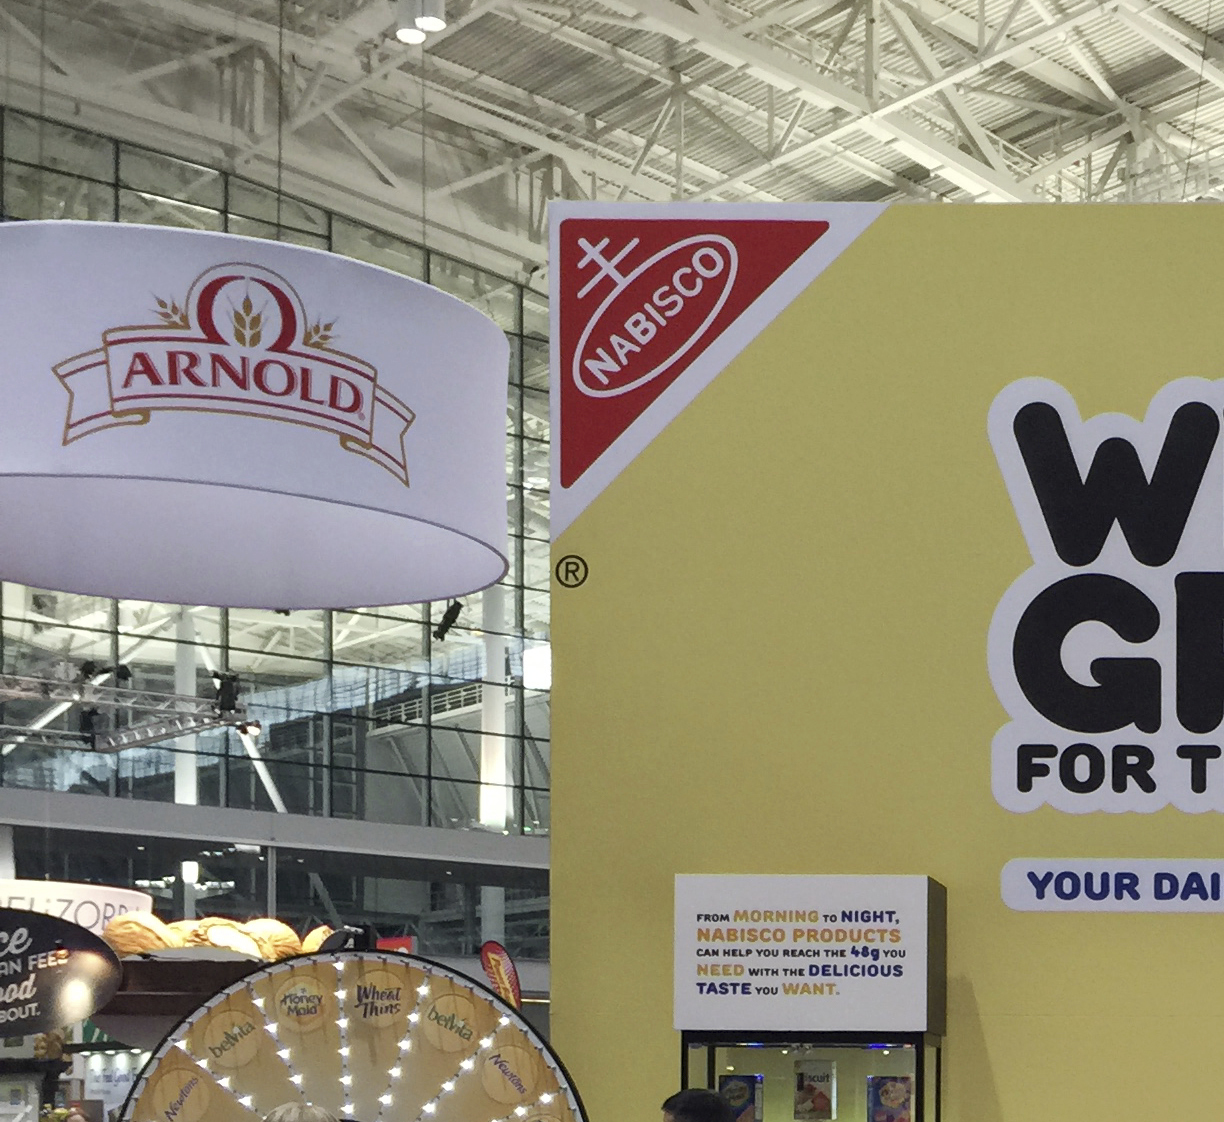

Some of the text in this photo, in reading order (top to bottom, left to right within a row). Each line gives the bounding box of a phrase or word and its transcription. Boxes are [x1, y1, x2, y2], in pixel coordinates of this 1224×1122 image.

[585, 247, 725, 385] NABISCO
[122, 350, 364, 414] ARNOLD
[1016, 744, 1157, 794] FOR
[1027, 872, 1141, 902] YOUR
[697, 910, 900, 925] FROM MORNING TO NIGHT,
[697, 928, 902, 943] NABISCO PRODUCTS
[696, 946, 906, 961] CAN HELP YOU REACH THE 48g YOU
[697, 964, 904, 977] NEED WITH THE DELICIOUS
[356, 982, 402, 1004] Wheat
[696, 982, 841, 996] TASTE YOU WANT.
[280, 993, 323, 1007] Honey
[287, 1003, 317, 1017] Maid
[354, 1001, 400, 1018] Thins
[489, 1054, 527, 1095] Newtons
[164, 1077, 199, 1122] Newtons
